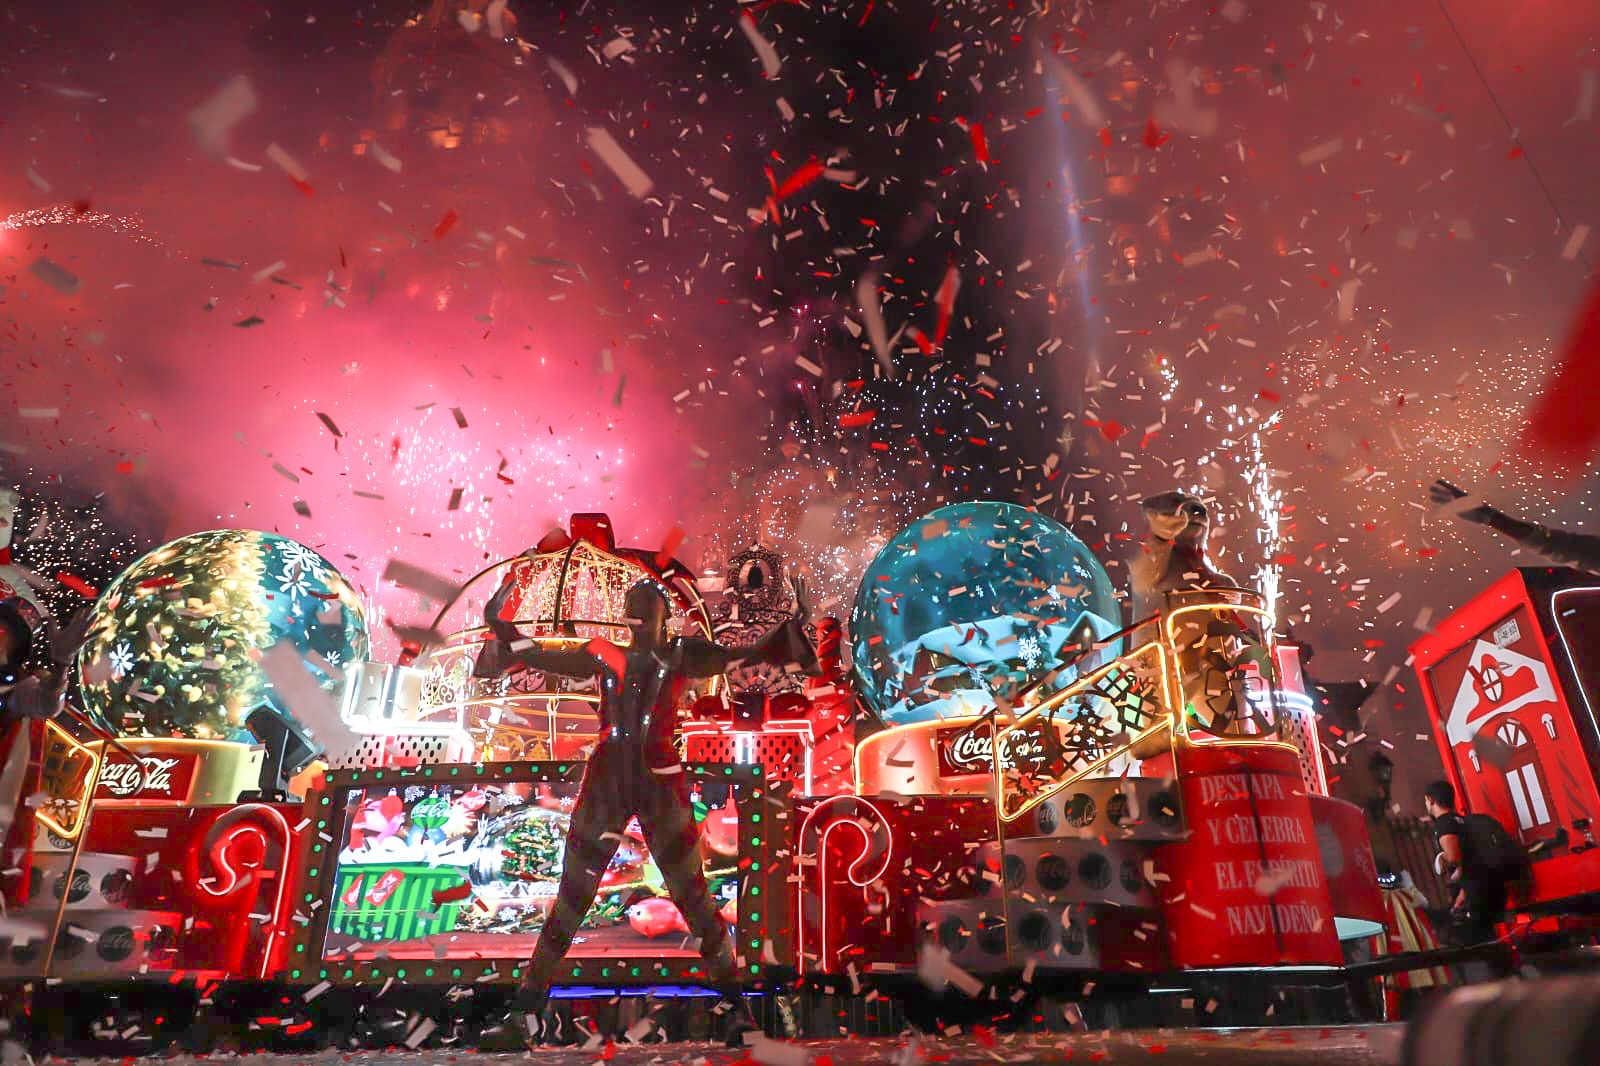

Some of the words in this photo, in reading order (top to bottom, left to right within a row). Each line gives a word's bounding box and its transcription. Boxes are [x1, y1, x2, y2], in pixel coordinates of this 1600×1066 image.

[954, 730, 1045, 763] CocaCoa
[1200, 774, 1284, 800] DESTAPA
[1207, 818, 1222, 846] Y
[1225, 816, 1306, 845] CELEBRA
[1215, 861, 1242, 889] EL
[1226, 901, 1321, 936] NAVIDEÑO
